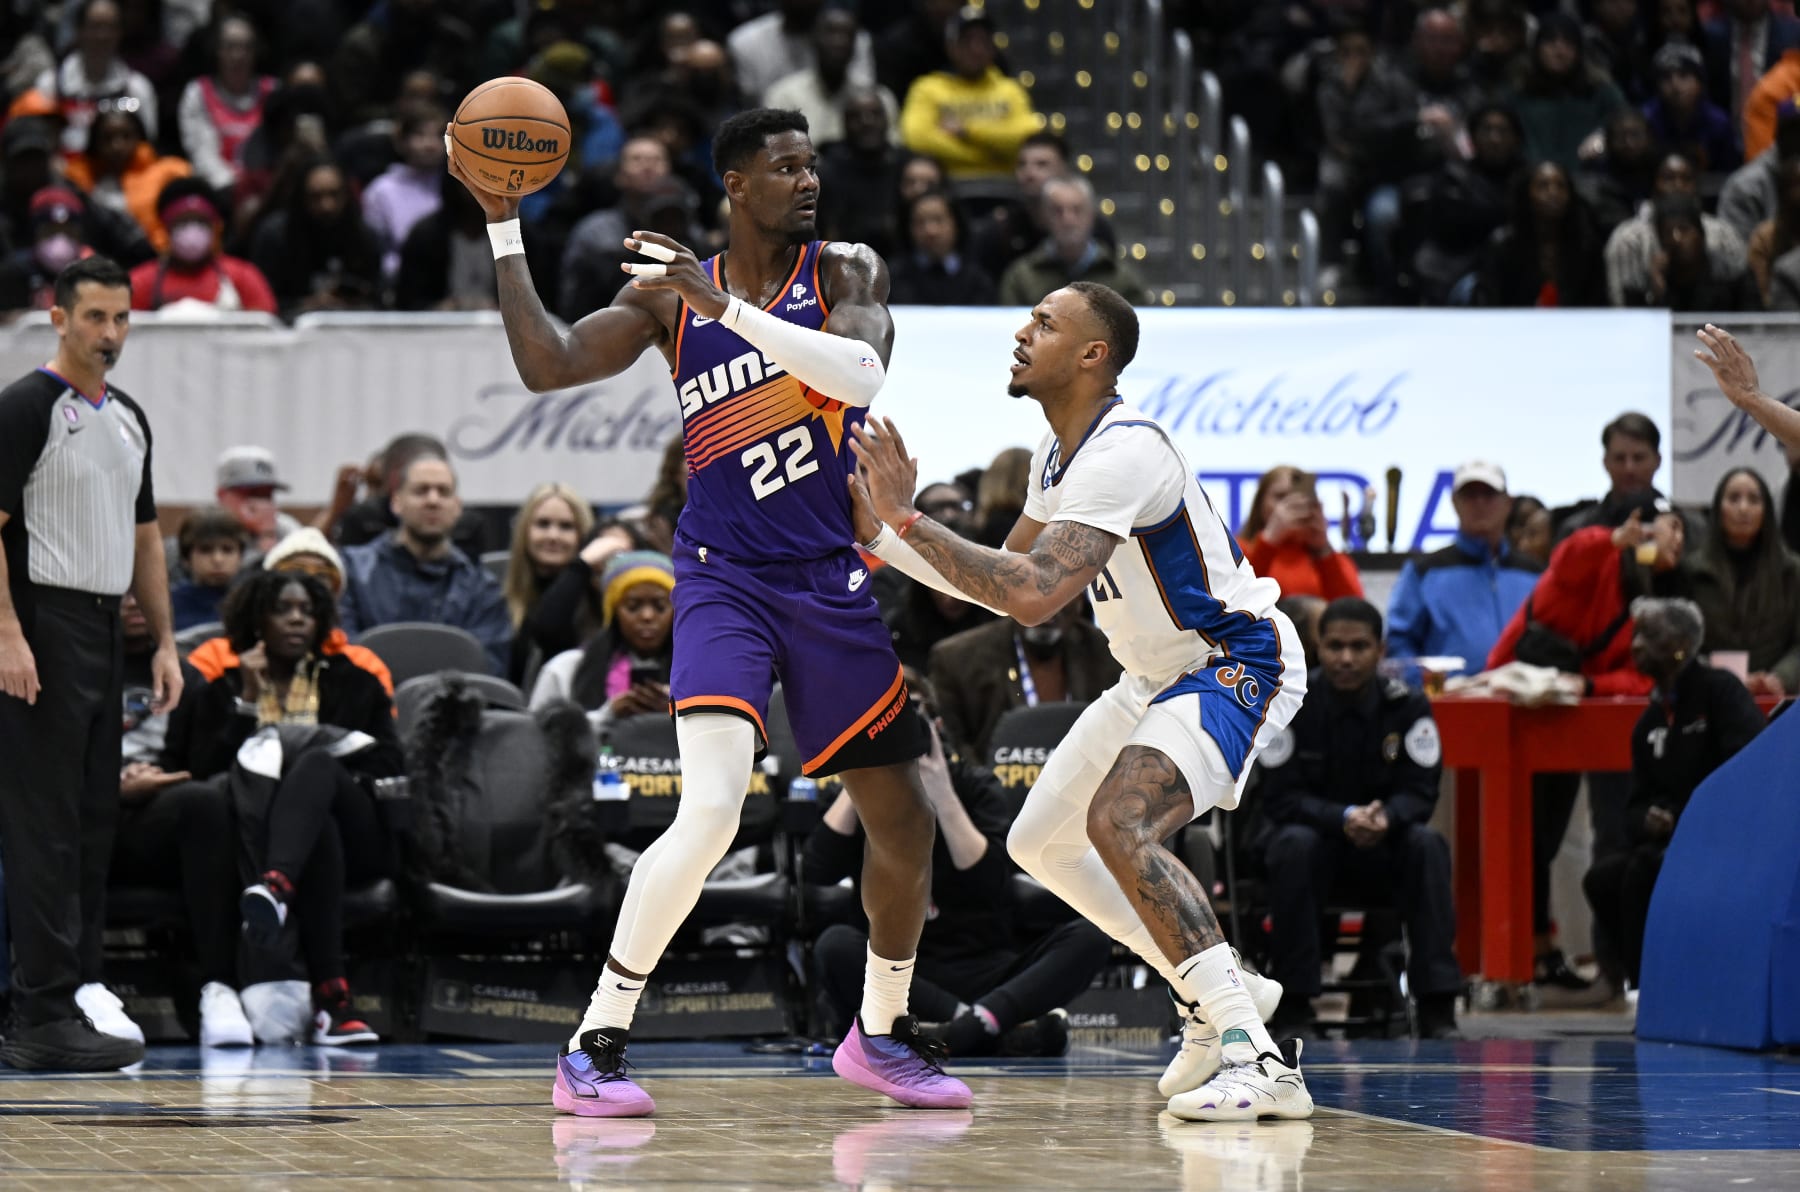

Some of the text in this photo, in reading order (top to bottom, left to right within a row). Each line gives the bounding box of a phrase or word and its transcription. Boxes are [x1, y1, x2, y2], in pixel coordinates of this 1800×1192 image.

[482, 127, 559, 154] Wilson
[786, 296, 817, 312] PayPal
[1137, 367, 1414, 437] Michelob
[449, 381, 684, 461] Miche
[741, 425, 819, 501] 22
[1090, 566, 1123, 602] 1
[613, 756, 682, 774] AESA
[994, 747, 1056, 765] CAES
[1067, 1013, 1119, 1027] ESARS
[1068, 1027, 1162, 1042] ORTSBOOK
